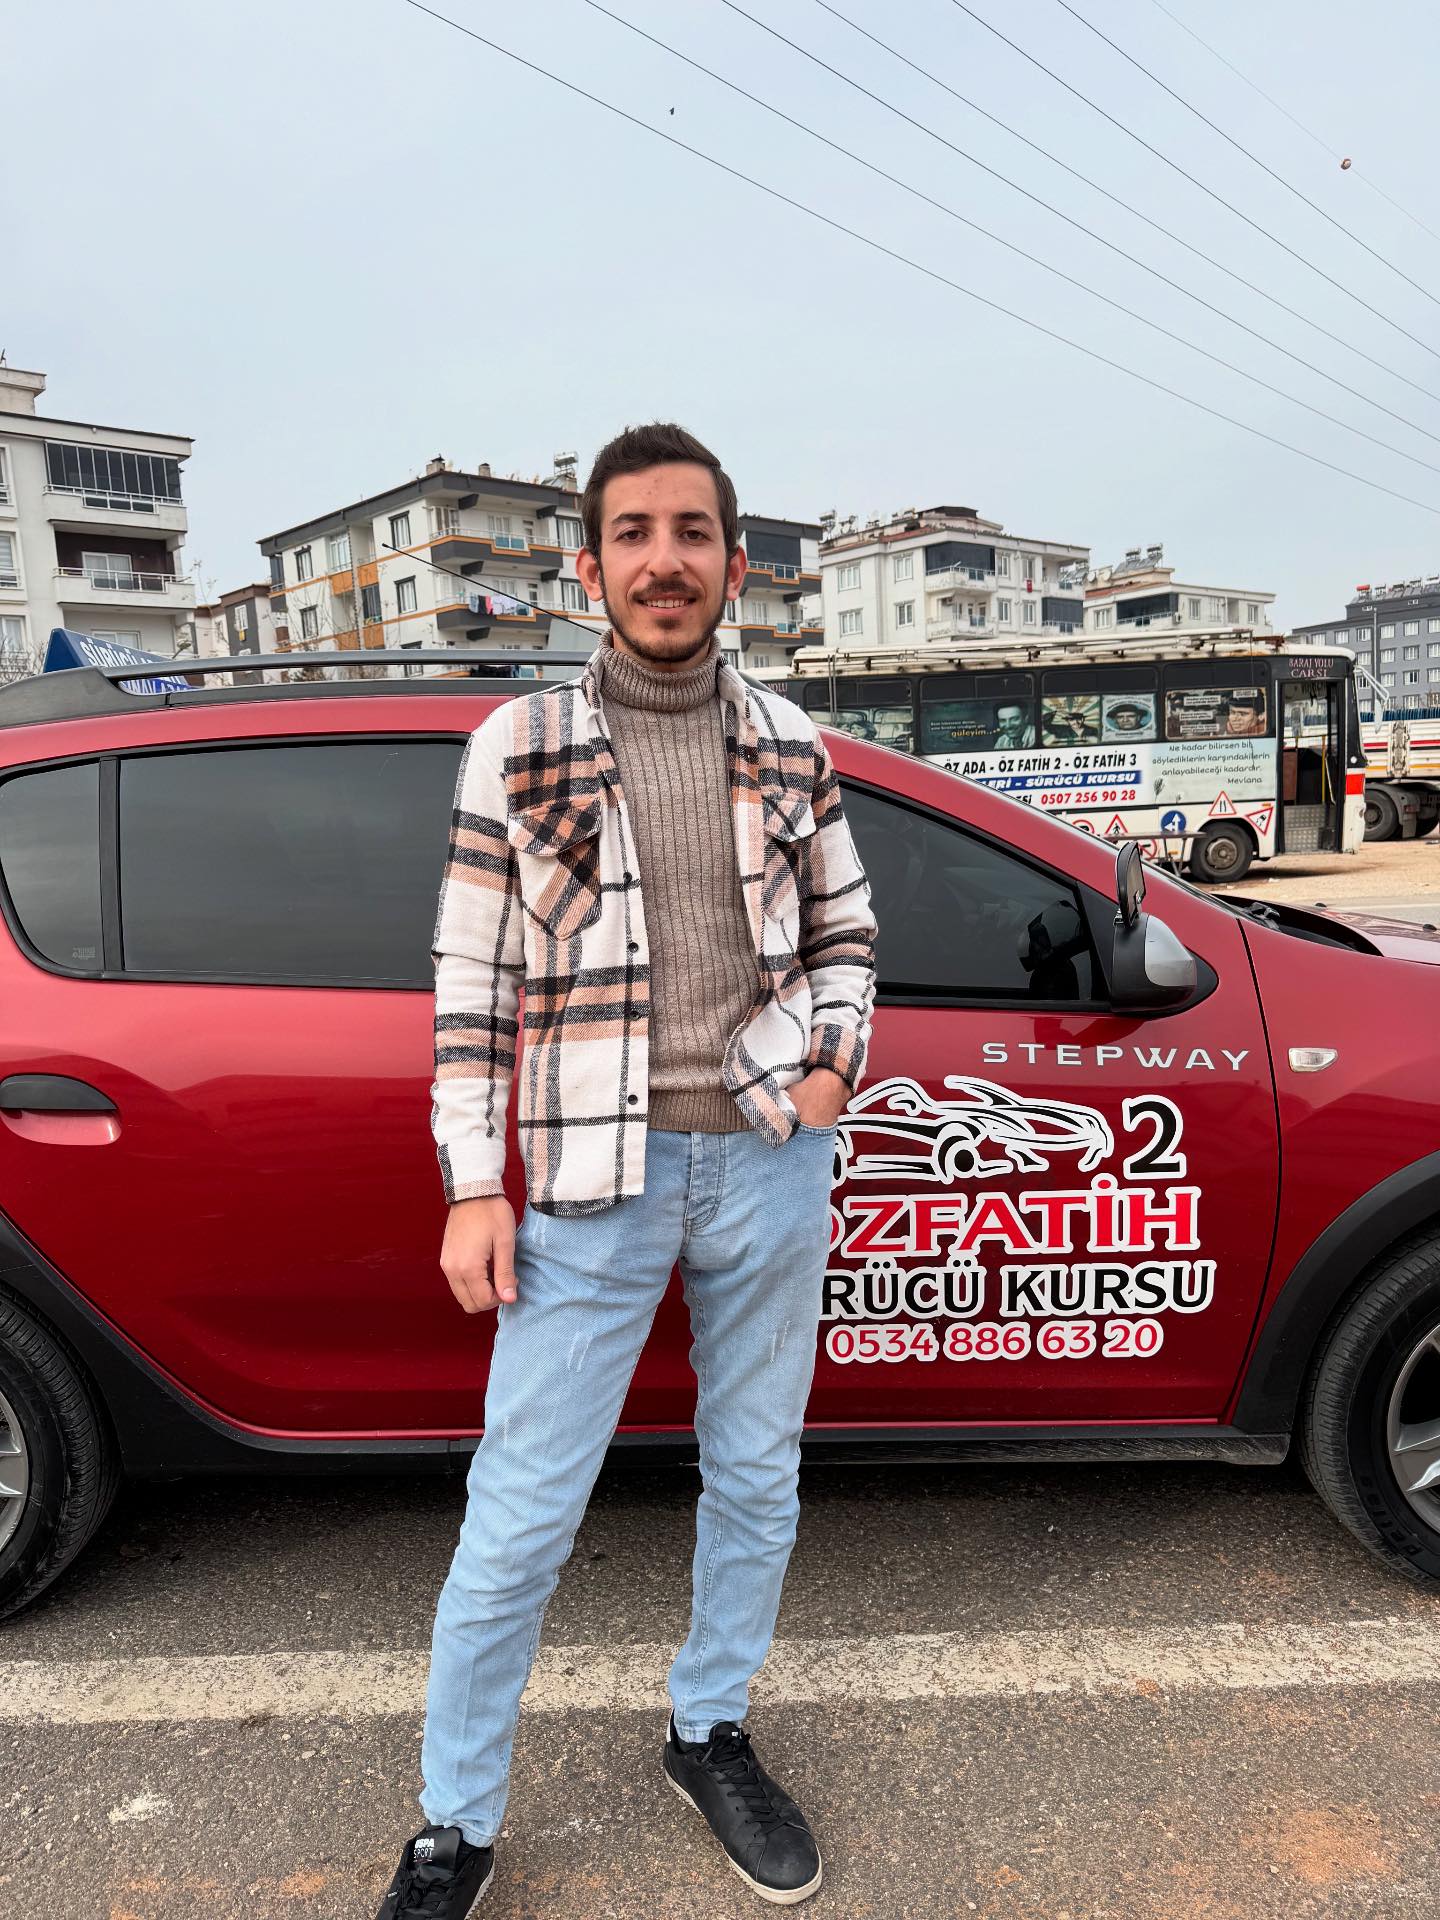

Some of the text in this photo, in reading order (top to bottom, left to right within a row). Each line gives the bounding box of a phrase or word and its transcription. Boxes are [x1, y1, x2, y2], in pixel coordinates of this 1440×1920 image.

[1182, 743, 1206, 752] kadar
[963, 760, 986, 775] ADA
[998, 756, 1015, 773] ÖZ
[1017, 754, 1051, 772] FATİH
[1054, 757, 1062, 770] 2
[1073, 752, 1090, 769] ÖZ
[1092, 750, 1126, 768] FATİH
[1129, 753, 1137, 766] 3
[1025, 773, 1084, 788] SÜRÜCÜ
[1086, 772, 1137, 785] KURSU
[1227, 776, 1263, 784] Mevlana
[1041, 792, 1072, 805] 0507
[1075, 791, 1098, 803] 256
[1102, 790, 1118, 802] 90
[1121, 789, 1137, 801] 28
[981, 1042, 1250, 1072] STEPWAY
[1127, 1099, 1182, 1175] 2
[829, 1178, 1194, 1253] ZFATİH
[1005, 1264, 1210, 1312] KURSU
[831, 1322, 1159, 1359] 0534 886 63 20
